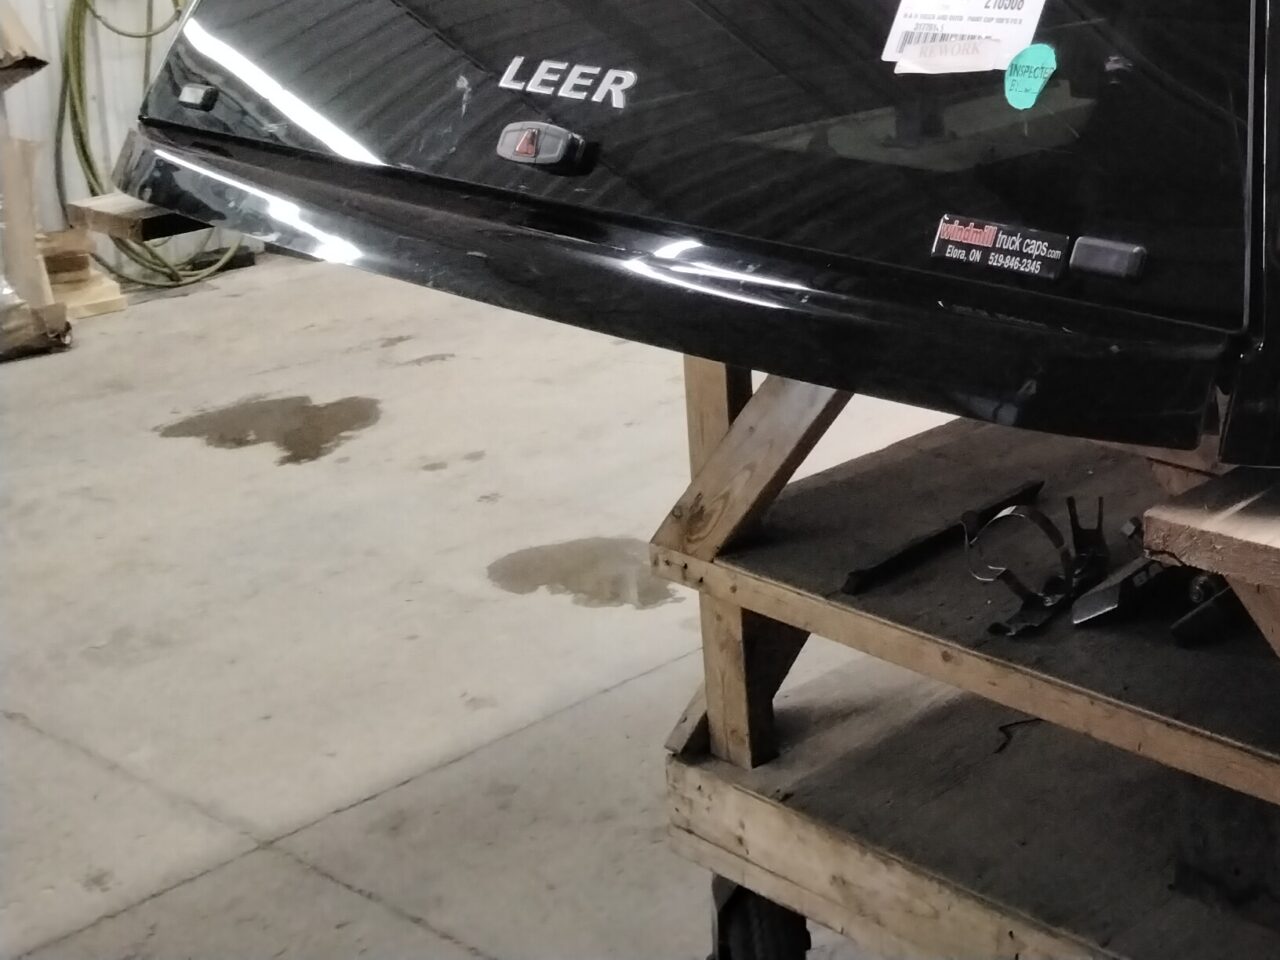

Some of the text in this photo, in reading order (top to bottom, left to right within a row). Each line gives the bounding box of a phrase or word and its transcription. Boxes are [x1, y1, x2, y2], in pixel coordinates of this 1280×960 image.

[498, 55, 638, 109] LEER
[996, 230, 1023, 252] truck
[945, 244, 1041, 274] Elora, ON 519-846-2345
